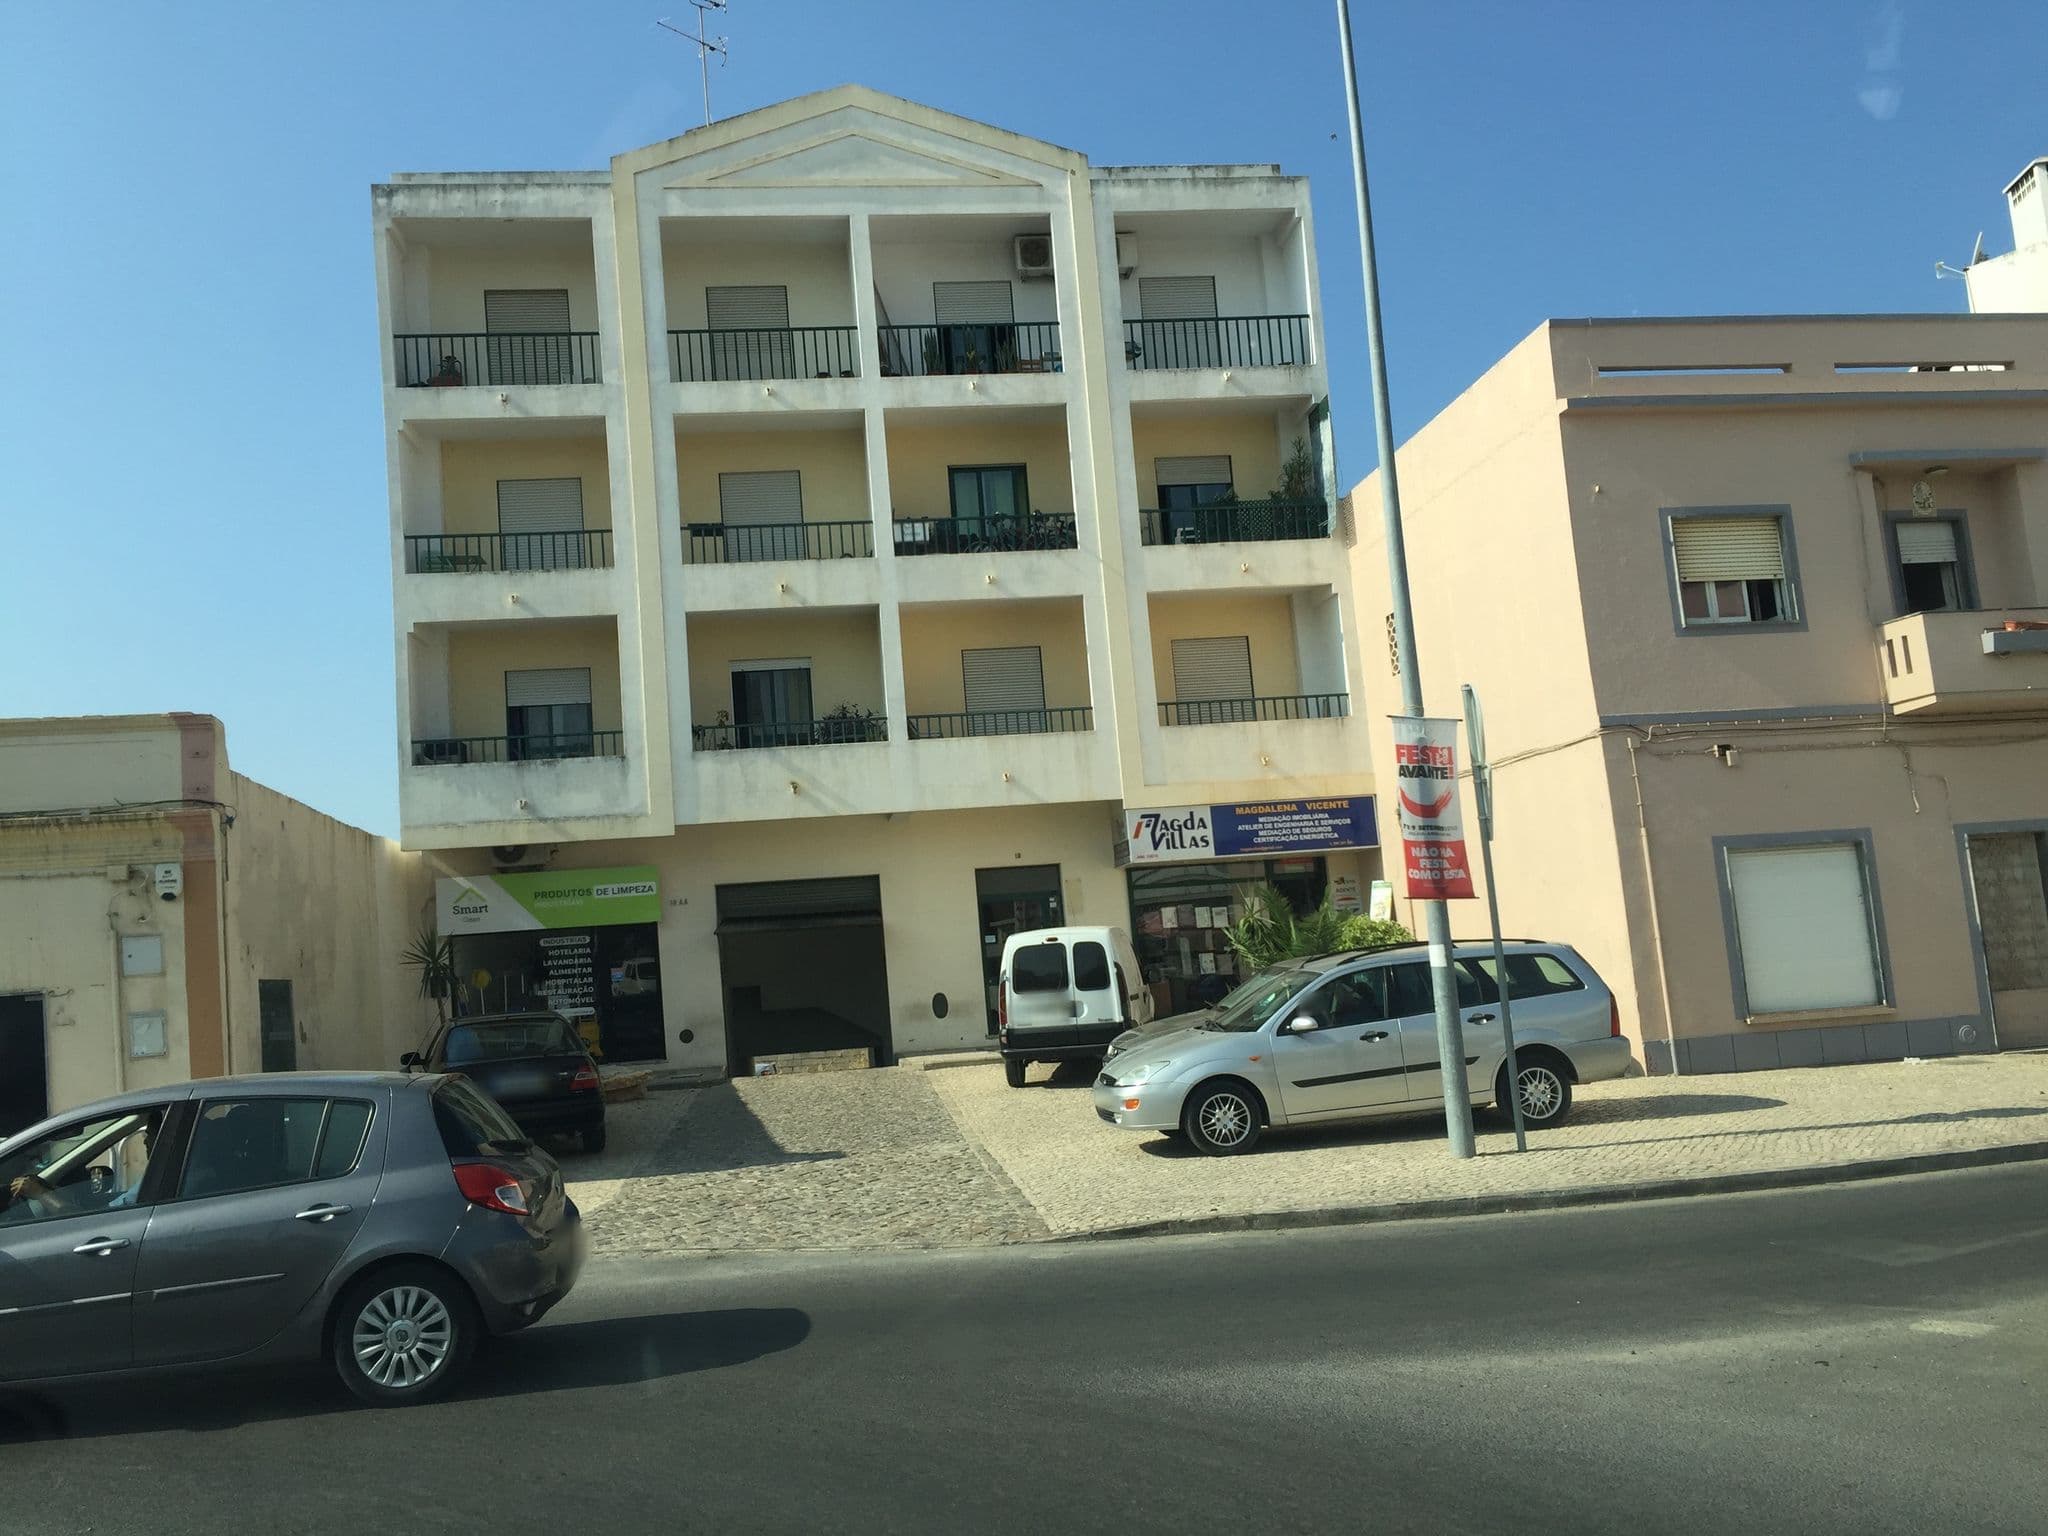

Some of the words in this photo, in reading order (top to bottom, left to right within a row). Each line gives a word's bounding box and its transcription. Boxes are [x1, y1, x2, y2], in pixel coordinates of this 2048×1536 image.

[1235, 804, 1298, 815] MAGDALENA
[1305, 801, 1350, 810] VICENTE
[1238, 823, 1263, 831] ATELIER
[1274, 820, 1314, 829] ENGENHARIA
[1321, 818, 1351, 826] SERVIÇOS
[1258, 828, 1291, 836] MEDIAÇÃO
[1253, 834, 1298, 843] CERTIFICAÇÃO
[1300, 832, 1339, 840] ENERGÉTICA
[1408, 868, 1441, 880] COMO
[534, 888, 592, 899] PRODUTOS
[596, 888, 609, 896] DE
[611, 884, 654, 895] LIMPEZA
[453, 904, 488, 915] Smart
[549, 947, 591, 956] HOTELARIA
[543, 957, 592, 966] LAVANDARIA
[549, 967, 592, 976] ALIMENTAR
[545, 977, 593, 986] HOSPITALAR
[538, 986, 594, 996] RESTAURAÇÃO
